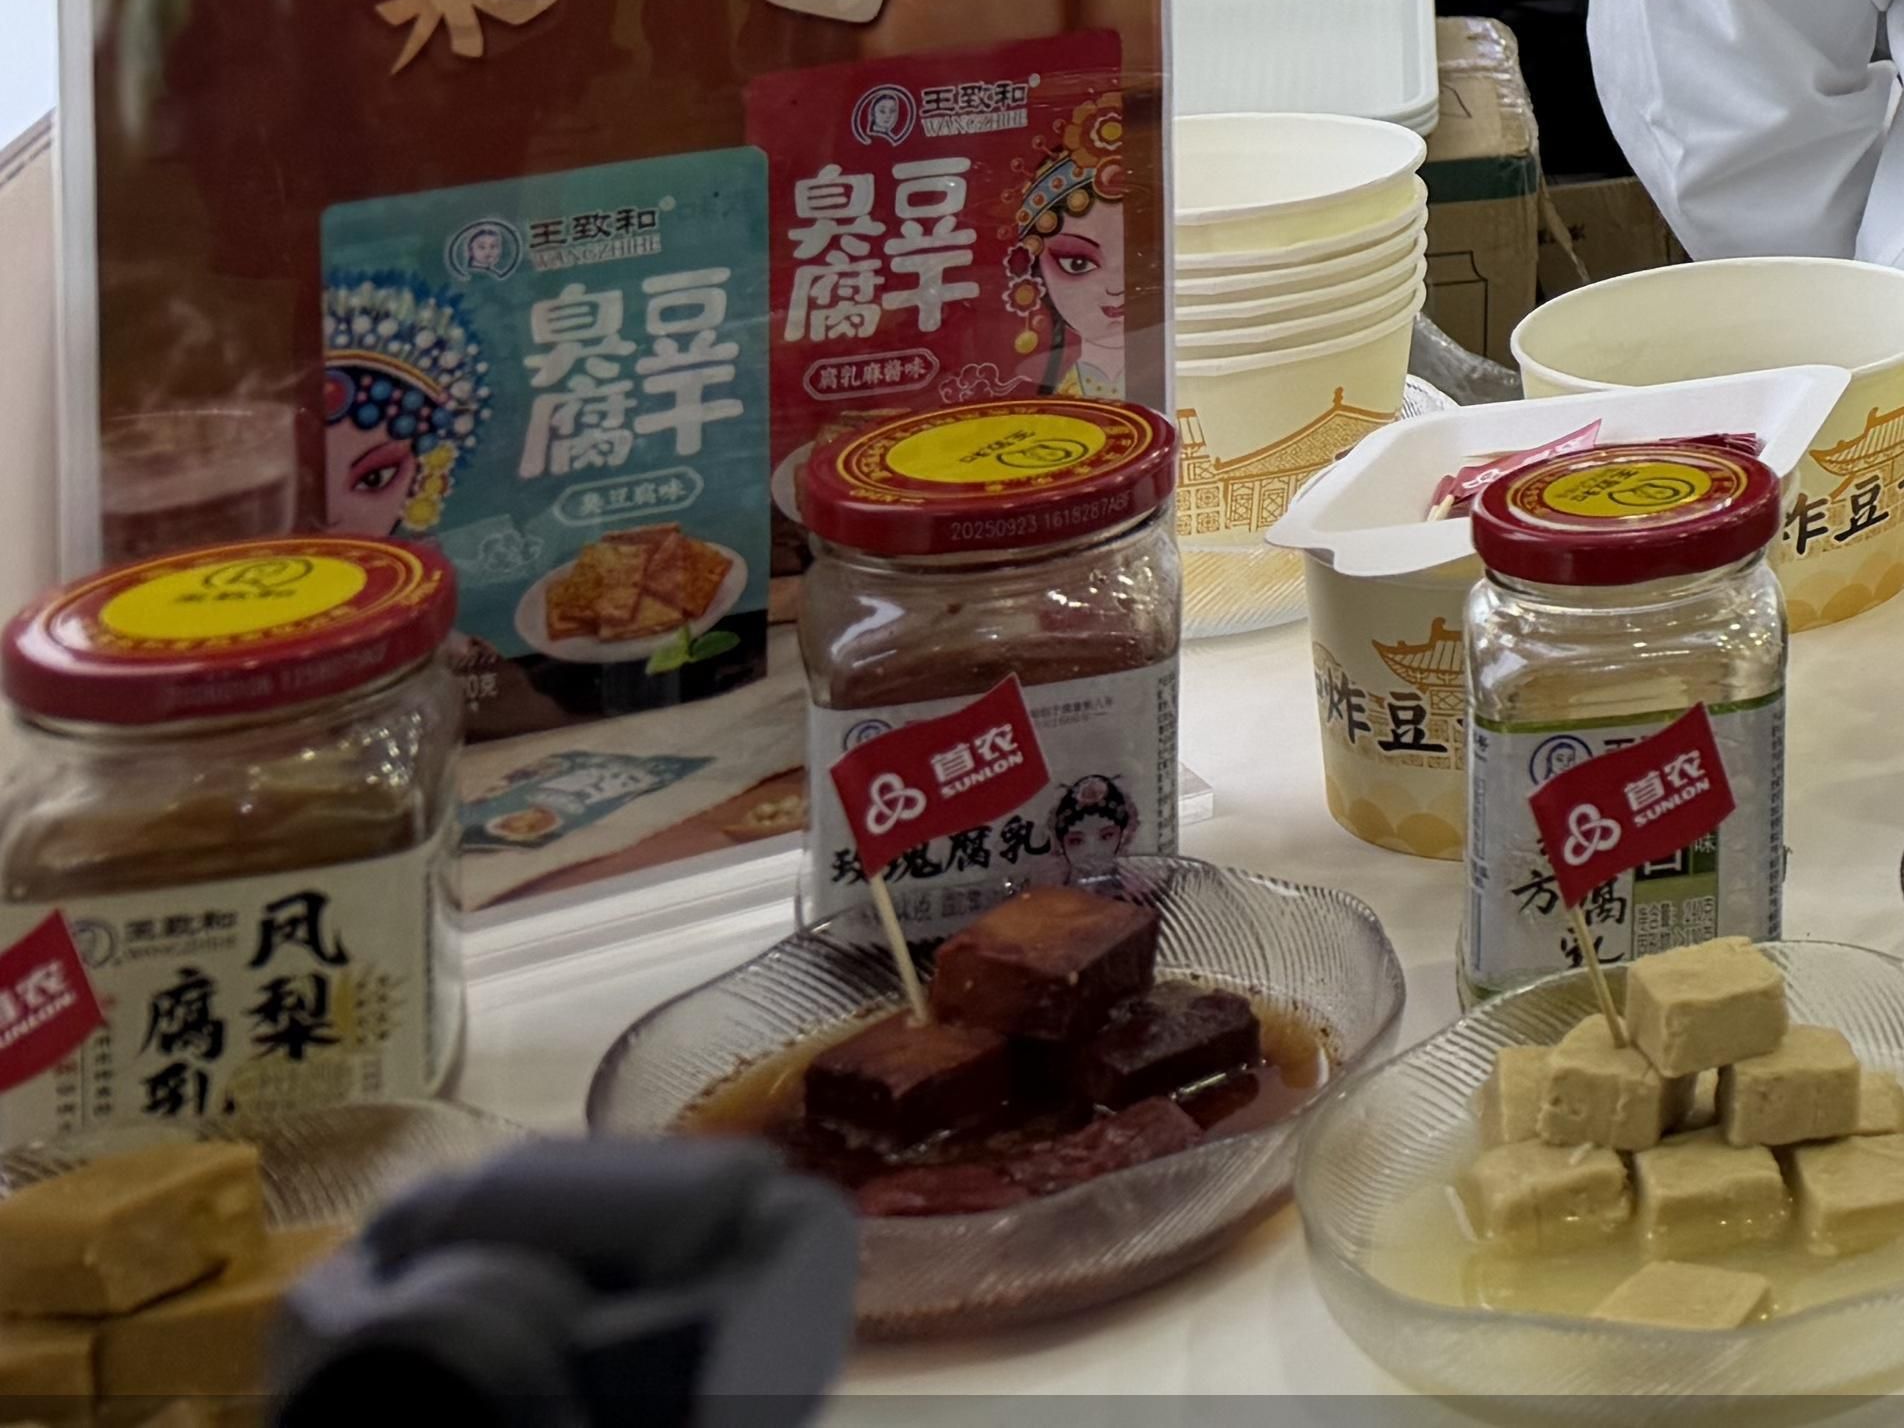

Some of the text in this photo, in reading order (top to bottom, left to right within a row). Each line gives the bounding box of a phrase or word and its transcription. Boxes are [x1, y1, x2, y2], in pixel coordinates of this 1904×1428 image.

[921, 81, 1029, 117] 王致和
[529, 205, 659, 250] 王致和
[529, 234, 661, 272] WANGZHIHE
[950, 513, 1038, 542] 20250923
[930, 722, 1019, 784] 首农
[939, 750, 1025, 800] SUNLON
[1624, 749, 1707, 812] 首农
[1633, 776, 1711, 828] SUNLON
[245, 889, 350, 1063] 凤梨
[136, 966, 238, 1118] 腐乳
